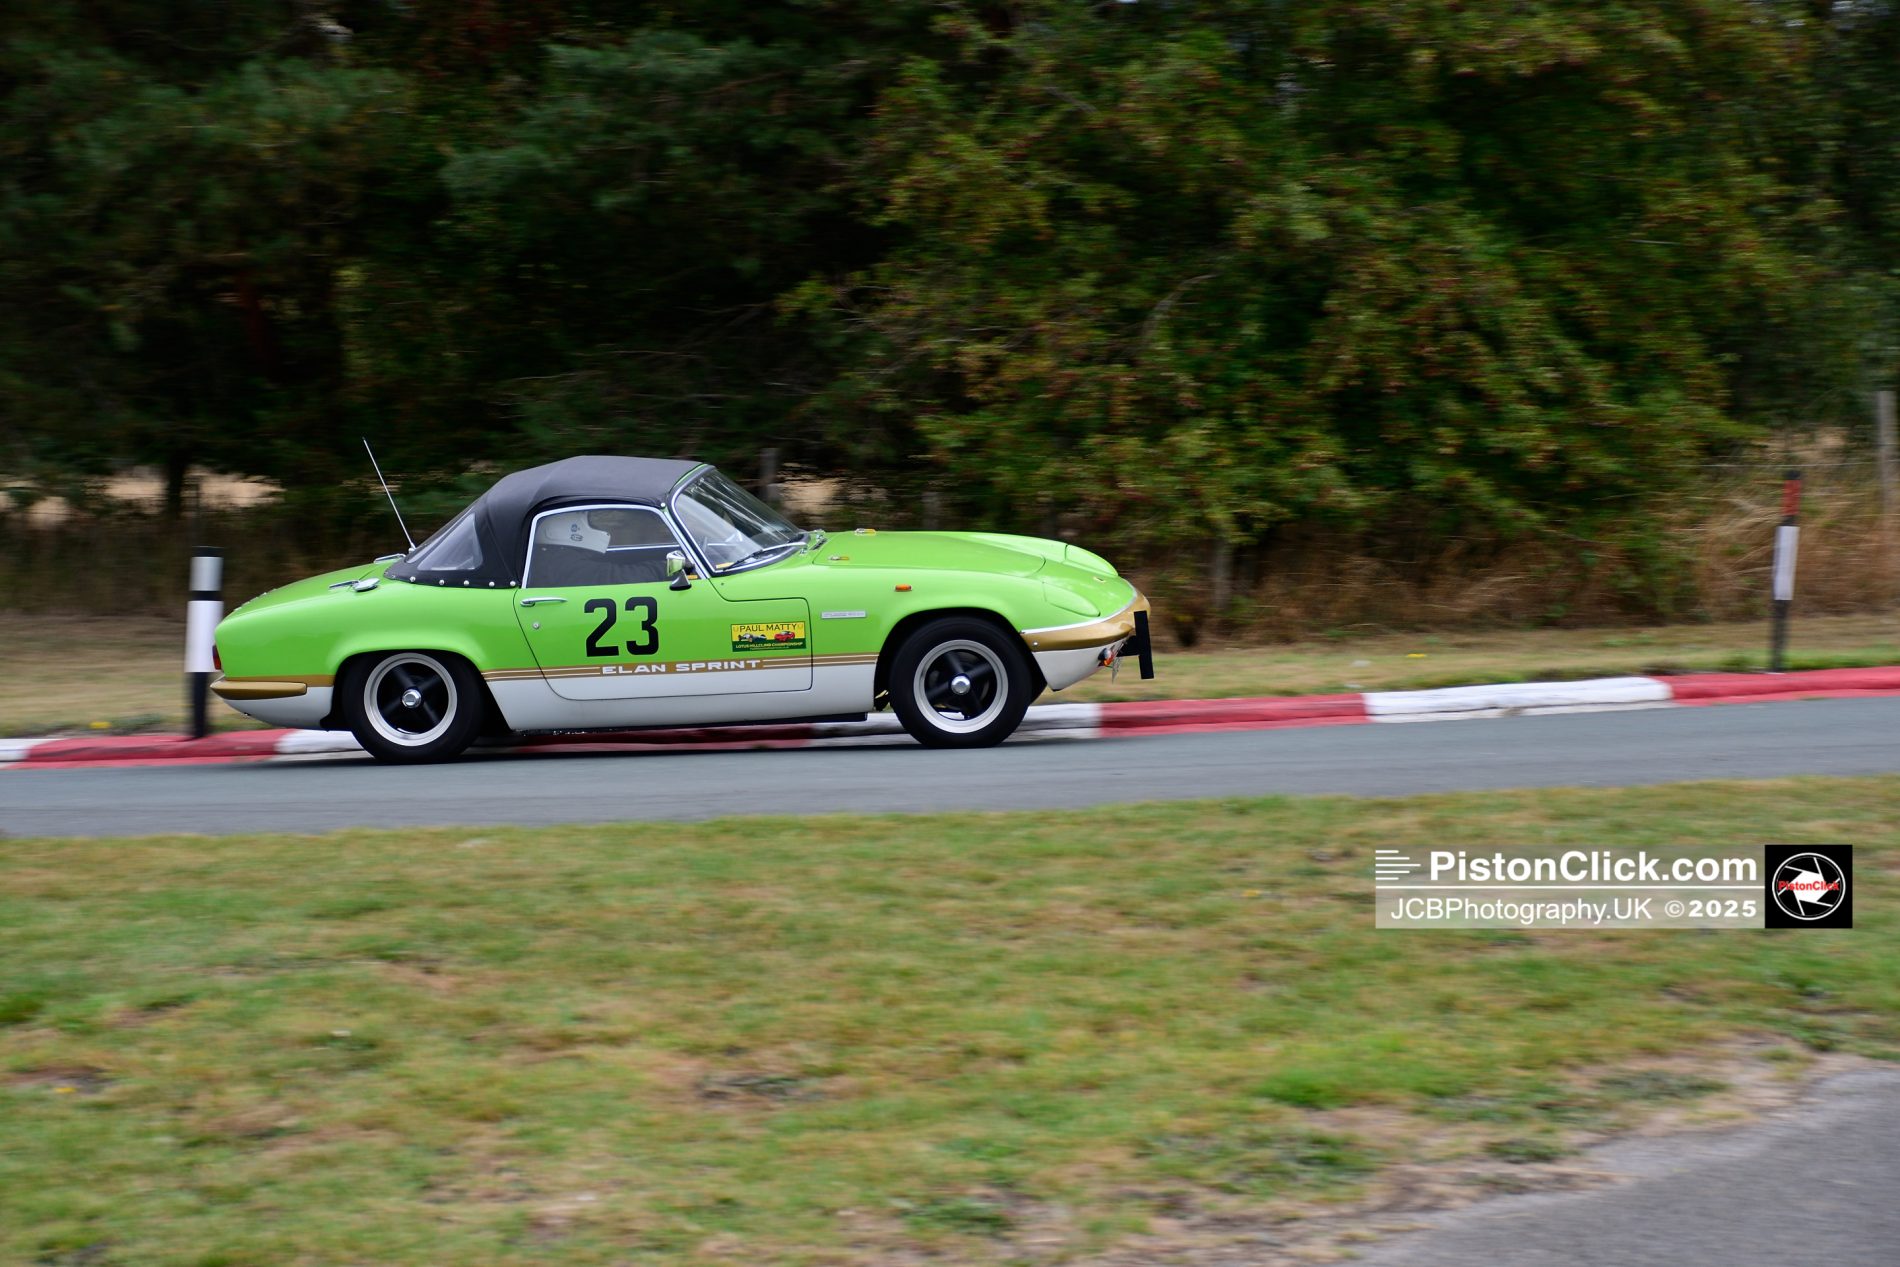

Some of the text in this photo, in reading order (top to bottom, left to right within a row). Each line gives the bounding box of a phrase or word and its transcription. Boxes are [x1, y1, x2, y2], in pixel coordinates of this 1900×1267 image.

[584, 596, 659, 657] 23
[766, 623, 797, 631] MATTY
[602, 660, 761, 675] ELAN SPRINT
